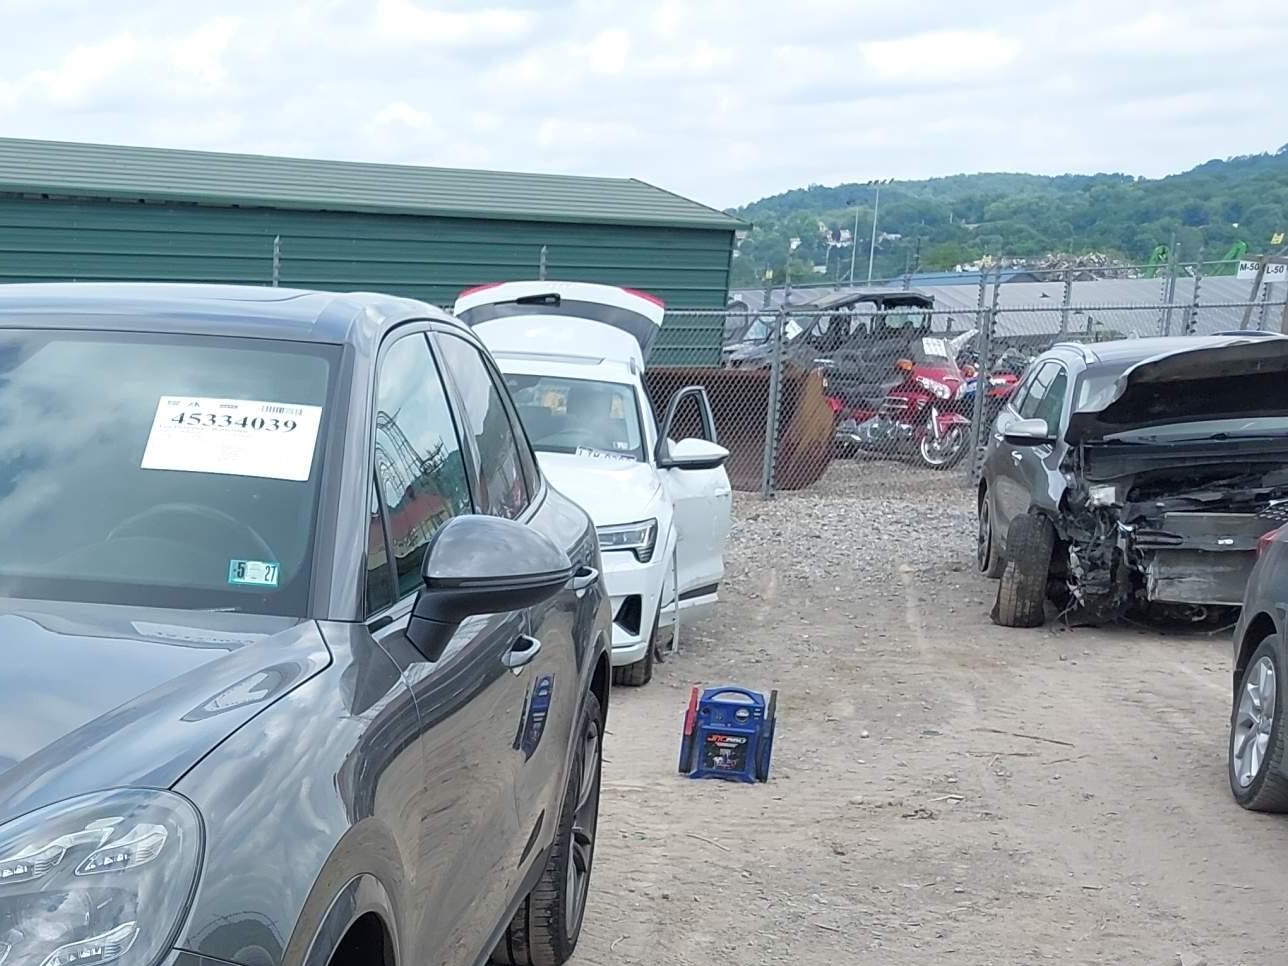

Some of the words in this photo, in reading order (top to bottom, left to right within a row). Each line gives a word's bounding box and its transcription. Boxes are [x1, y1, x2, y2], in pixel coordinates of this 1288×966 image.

[1240, 263, 1260, 271] M-50
[1266, 265, 1284, 274] L-50
[171, 412, 298, 433] 45334039
[264, 565, 276, 582] 27
